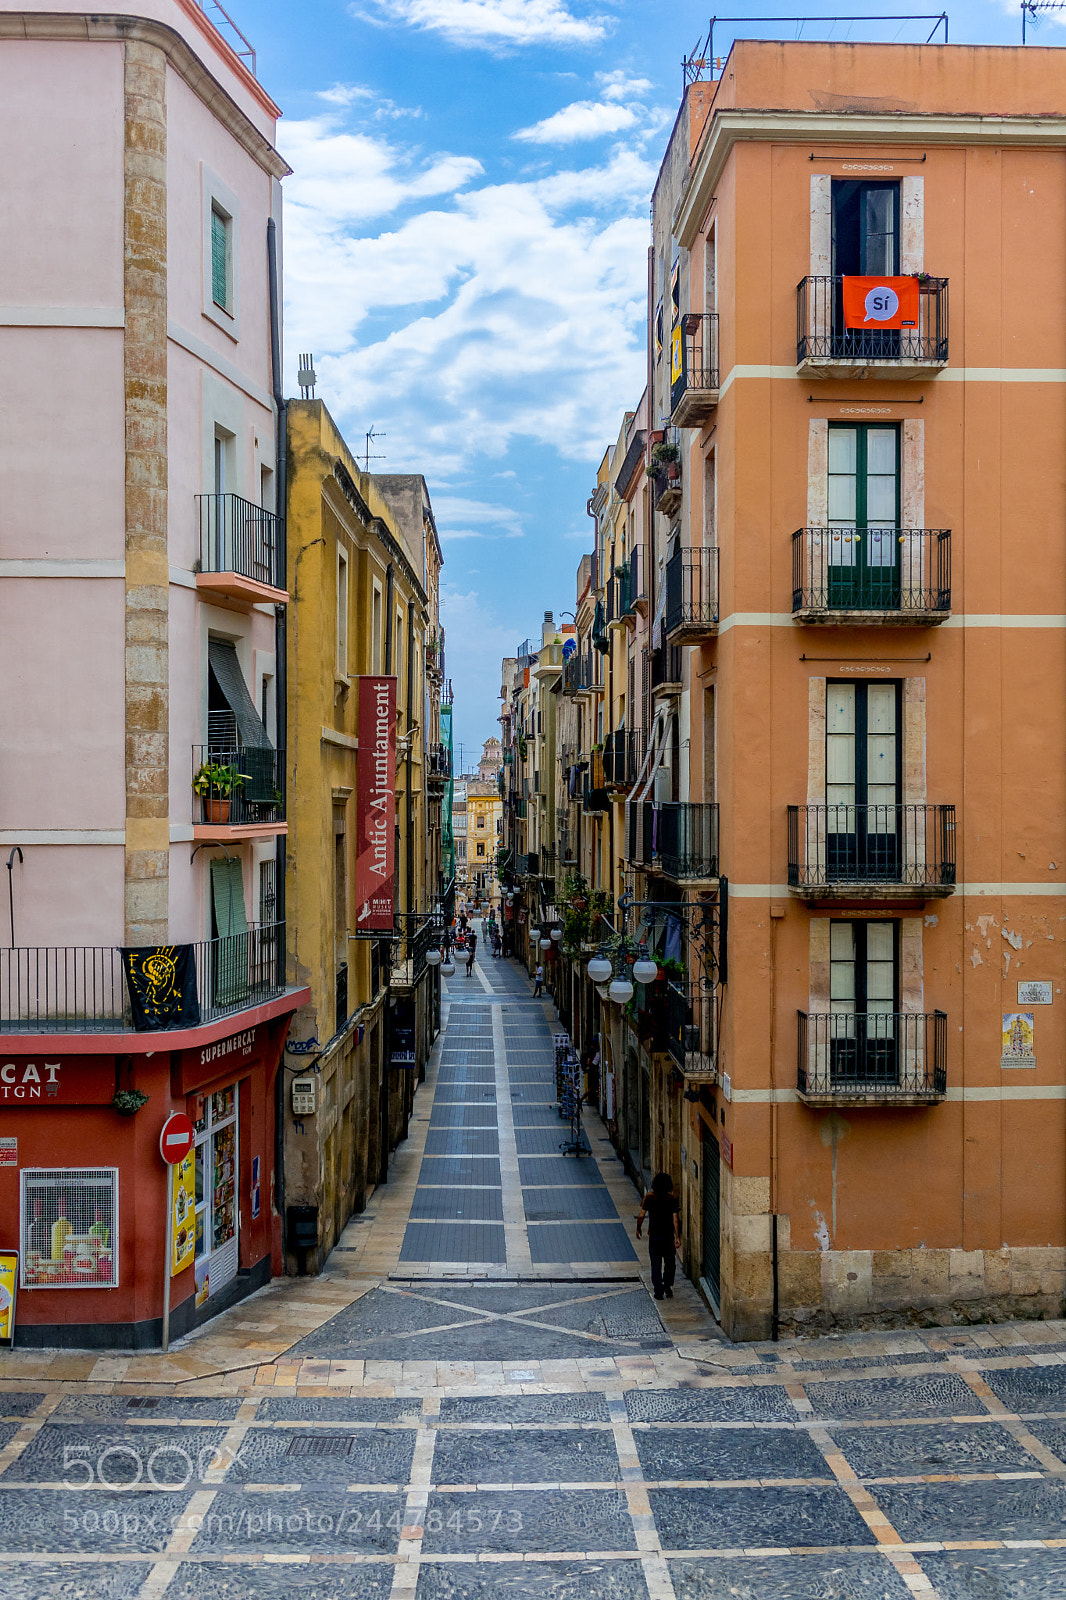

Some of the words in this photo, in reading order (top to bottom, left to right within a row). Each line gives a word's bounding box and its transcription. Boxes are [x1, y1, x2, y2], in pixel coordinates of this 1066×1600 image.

[873, 296, 890, 311] Sí
[370, 683, 394, 813] Ajuntament
[369, 819, 387, 878] Antic
[200, 1029, 256, 1065] SUPERMERCAT
[242, 1046, 252, 1056] TGN
[0, 1063, 61, 1083] CAT
[1, 1086, 41, 1098] TGN
